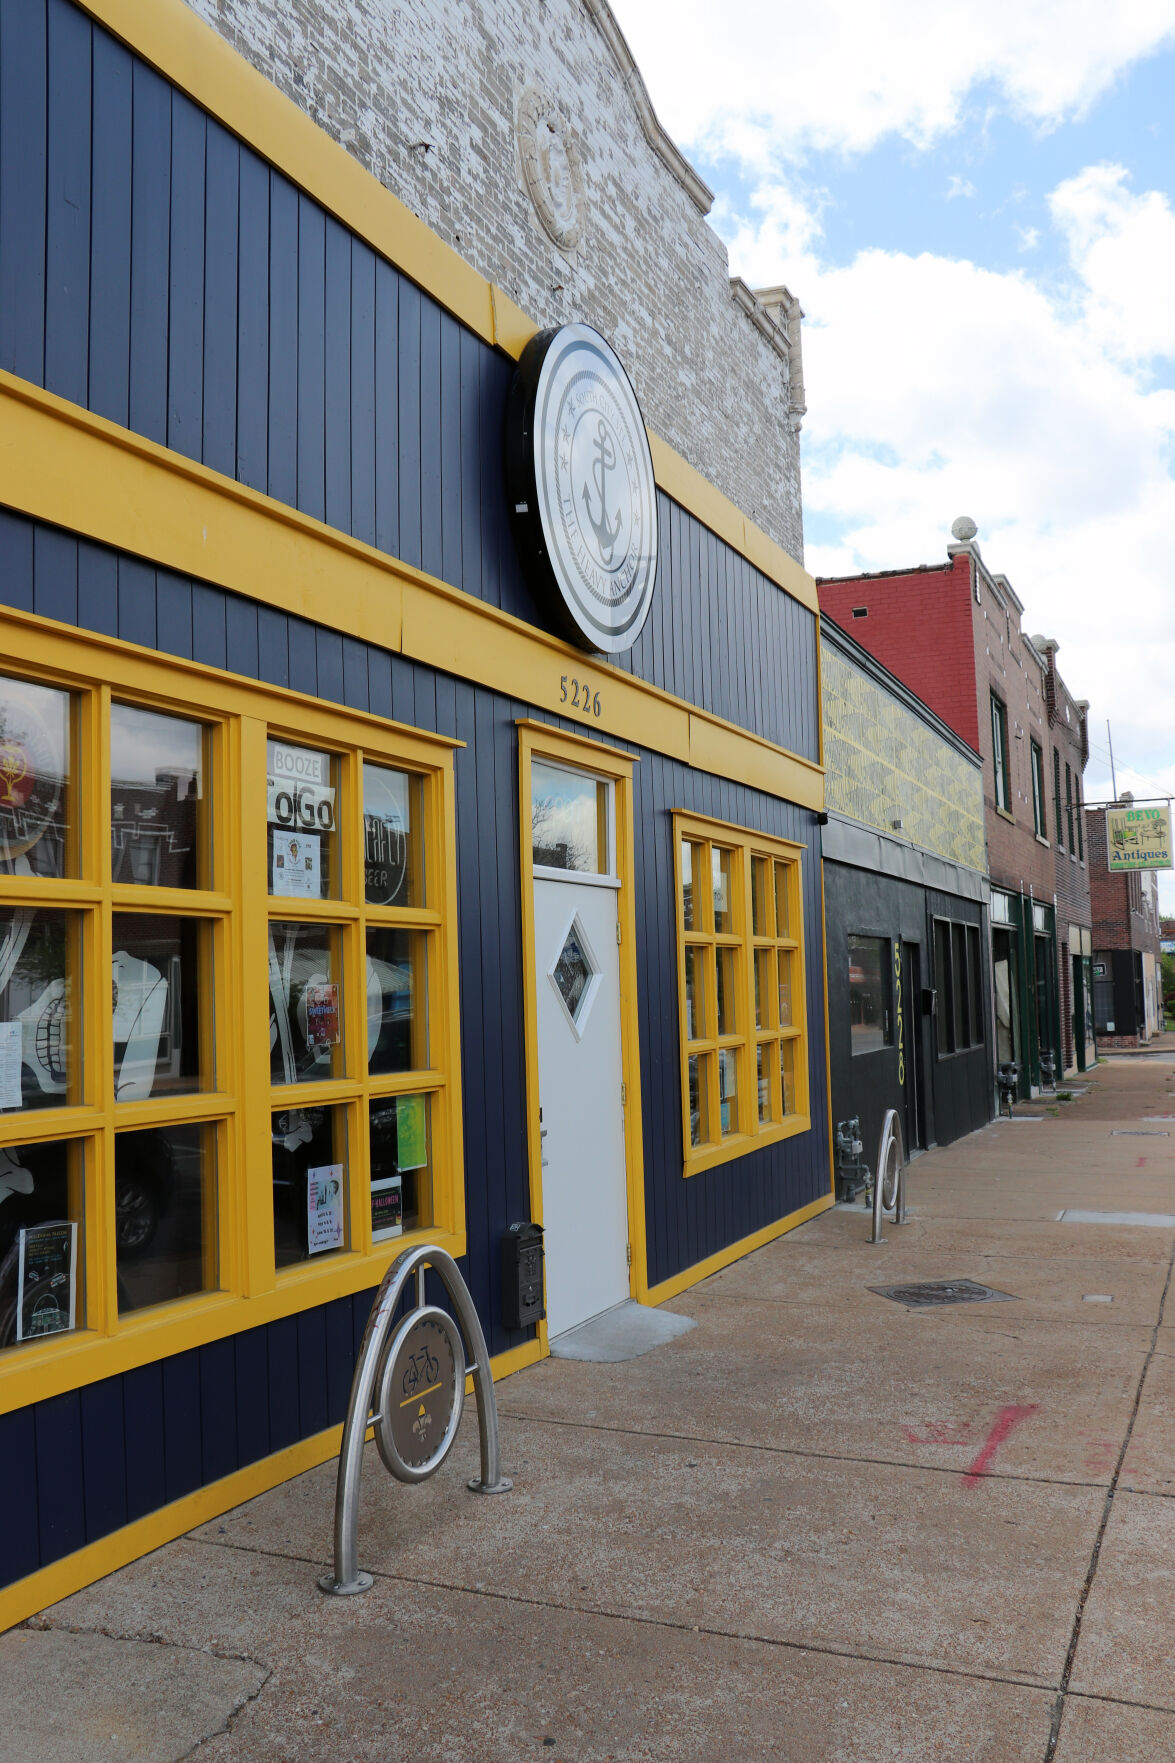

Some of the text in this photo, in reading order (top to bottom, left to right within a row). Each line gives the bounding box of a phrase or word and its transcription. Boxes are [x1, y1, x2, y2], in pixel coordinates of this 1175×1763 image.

[577, 544, 607, 595] HEAVY
[609, 543, 639, 597] ANCHOR
[559, 675, 602, 718] 5226
[275, 750, 320, 779] BOOZE
[1125, 808, 1161, 822] BEVO
[1112, 848, 1168, 861] Antiques
[364, 868, 388, 887] EER
[894, 942, 905, 1086] 5228
